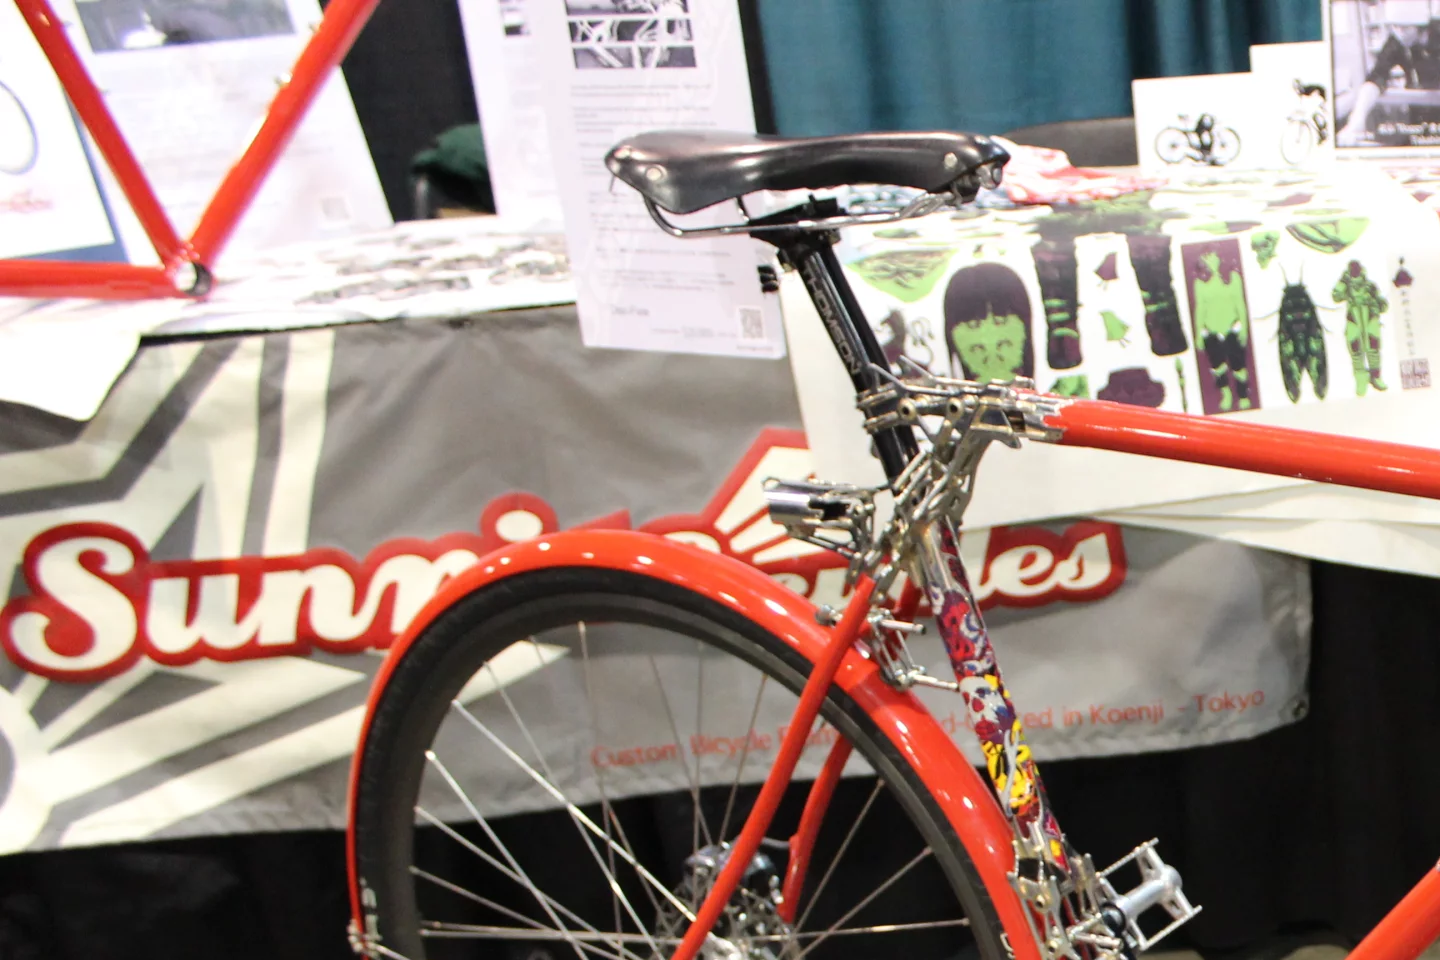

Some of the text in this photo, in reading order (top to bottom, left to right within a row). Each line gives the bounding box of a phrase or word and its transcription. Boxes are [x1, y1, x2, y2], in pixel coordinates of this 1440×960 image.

[803, 258, 862, 374] THOMSON
[1062, 706, 1084, 727] in
[1091, 702, 1165, 726] Koenji
[1192, 688, 1266, 715] Tokyo
